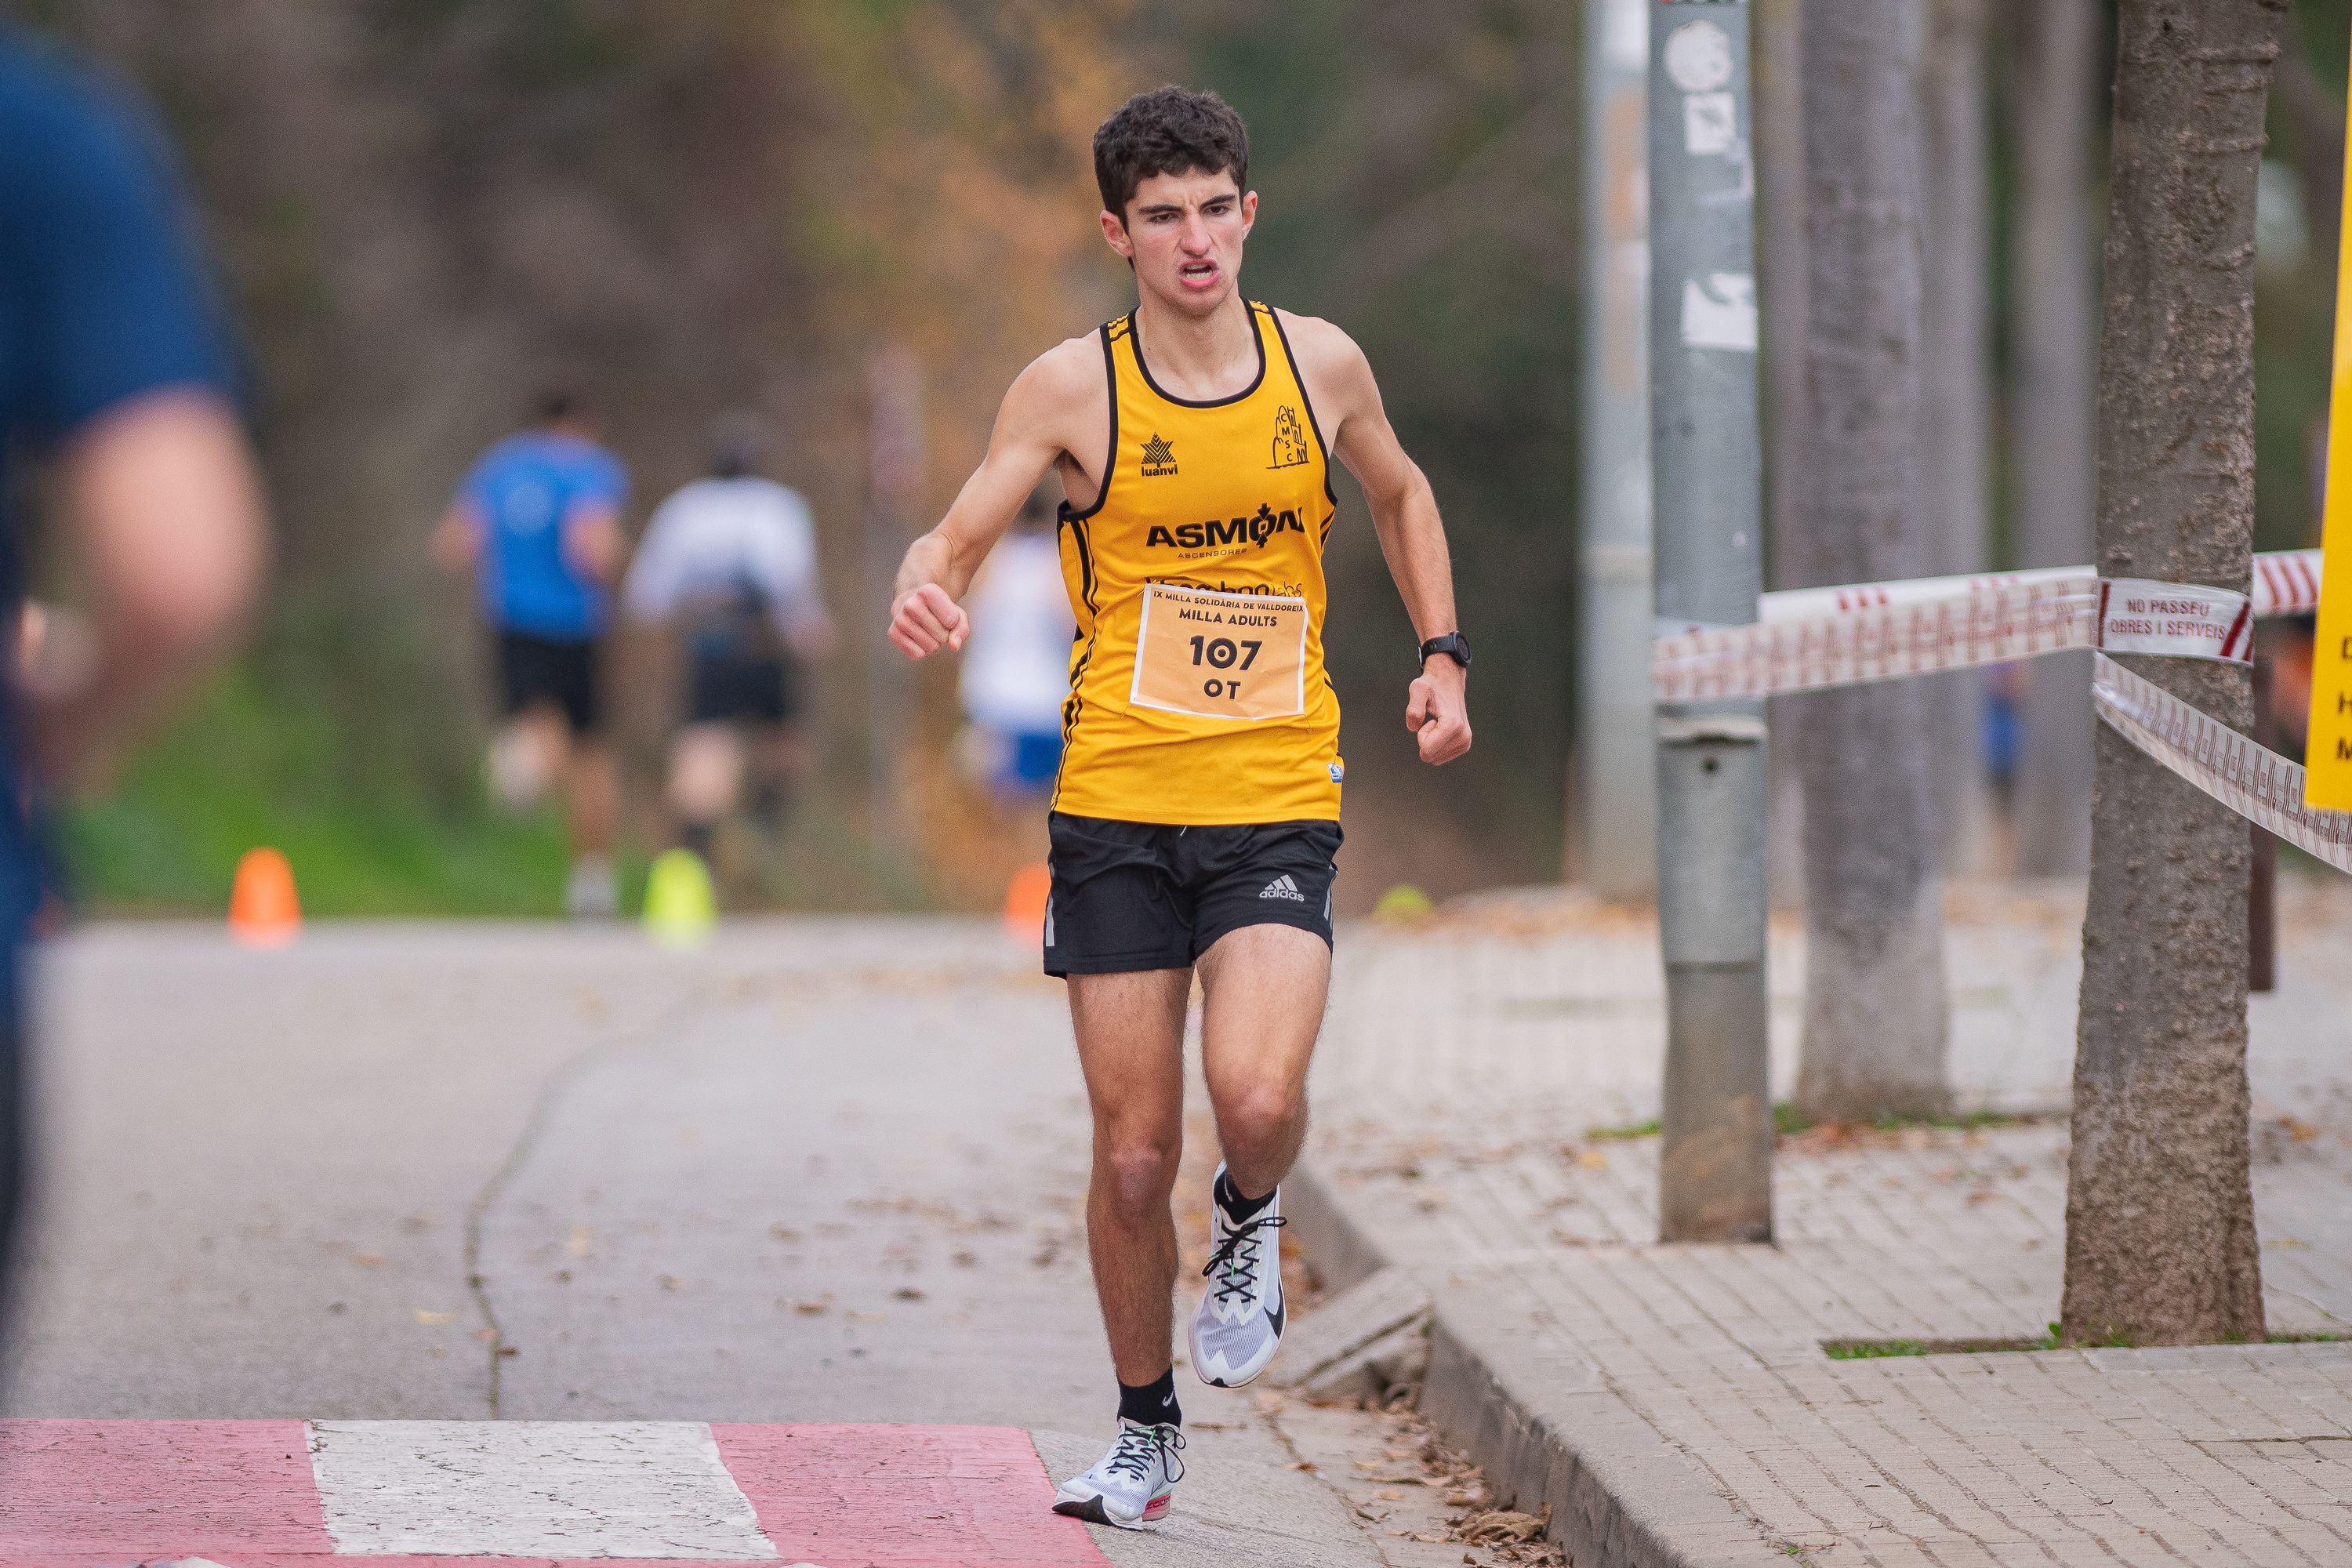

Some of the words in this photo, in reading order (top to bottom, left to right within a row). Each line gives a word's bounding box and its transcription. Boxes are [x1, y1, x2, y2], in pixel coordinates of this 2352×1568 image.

[1141, 465, 1178, 477] luanvi
[1146, 506, 1306, 548] ASMON
[1178, 548, 1247, 559] ASCENSORES
[1165, 593, 1192, 603] MILLA
[1194, 597, 1240, 609] SOLIDÀRIA
[1257, 603, 1304, 612] VALLDOREIX
[2127, 598, 2145, 613] NO
[2151, 599, 2209, 617] PASSEU
[1178, 608, 1223, 623] MILLA
[1228, 614, 1278, 627] ADULTS
[2111, 619, 2153, 634] OBRES
[2158, 619, 2161, 634] I
[2167, 620, 2227, 641] SERVEIS
[1189, 635, 1263, 671] 107
[1203, 678, 1241, 700] OT
[1258, 887, 1305, 902] adidas
